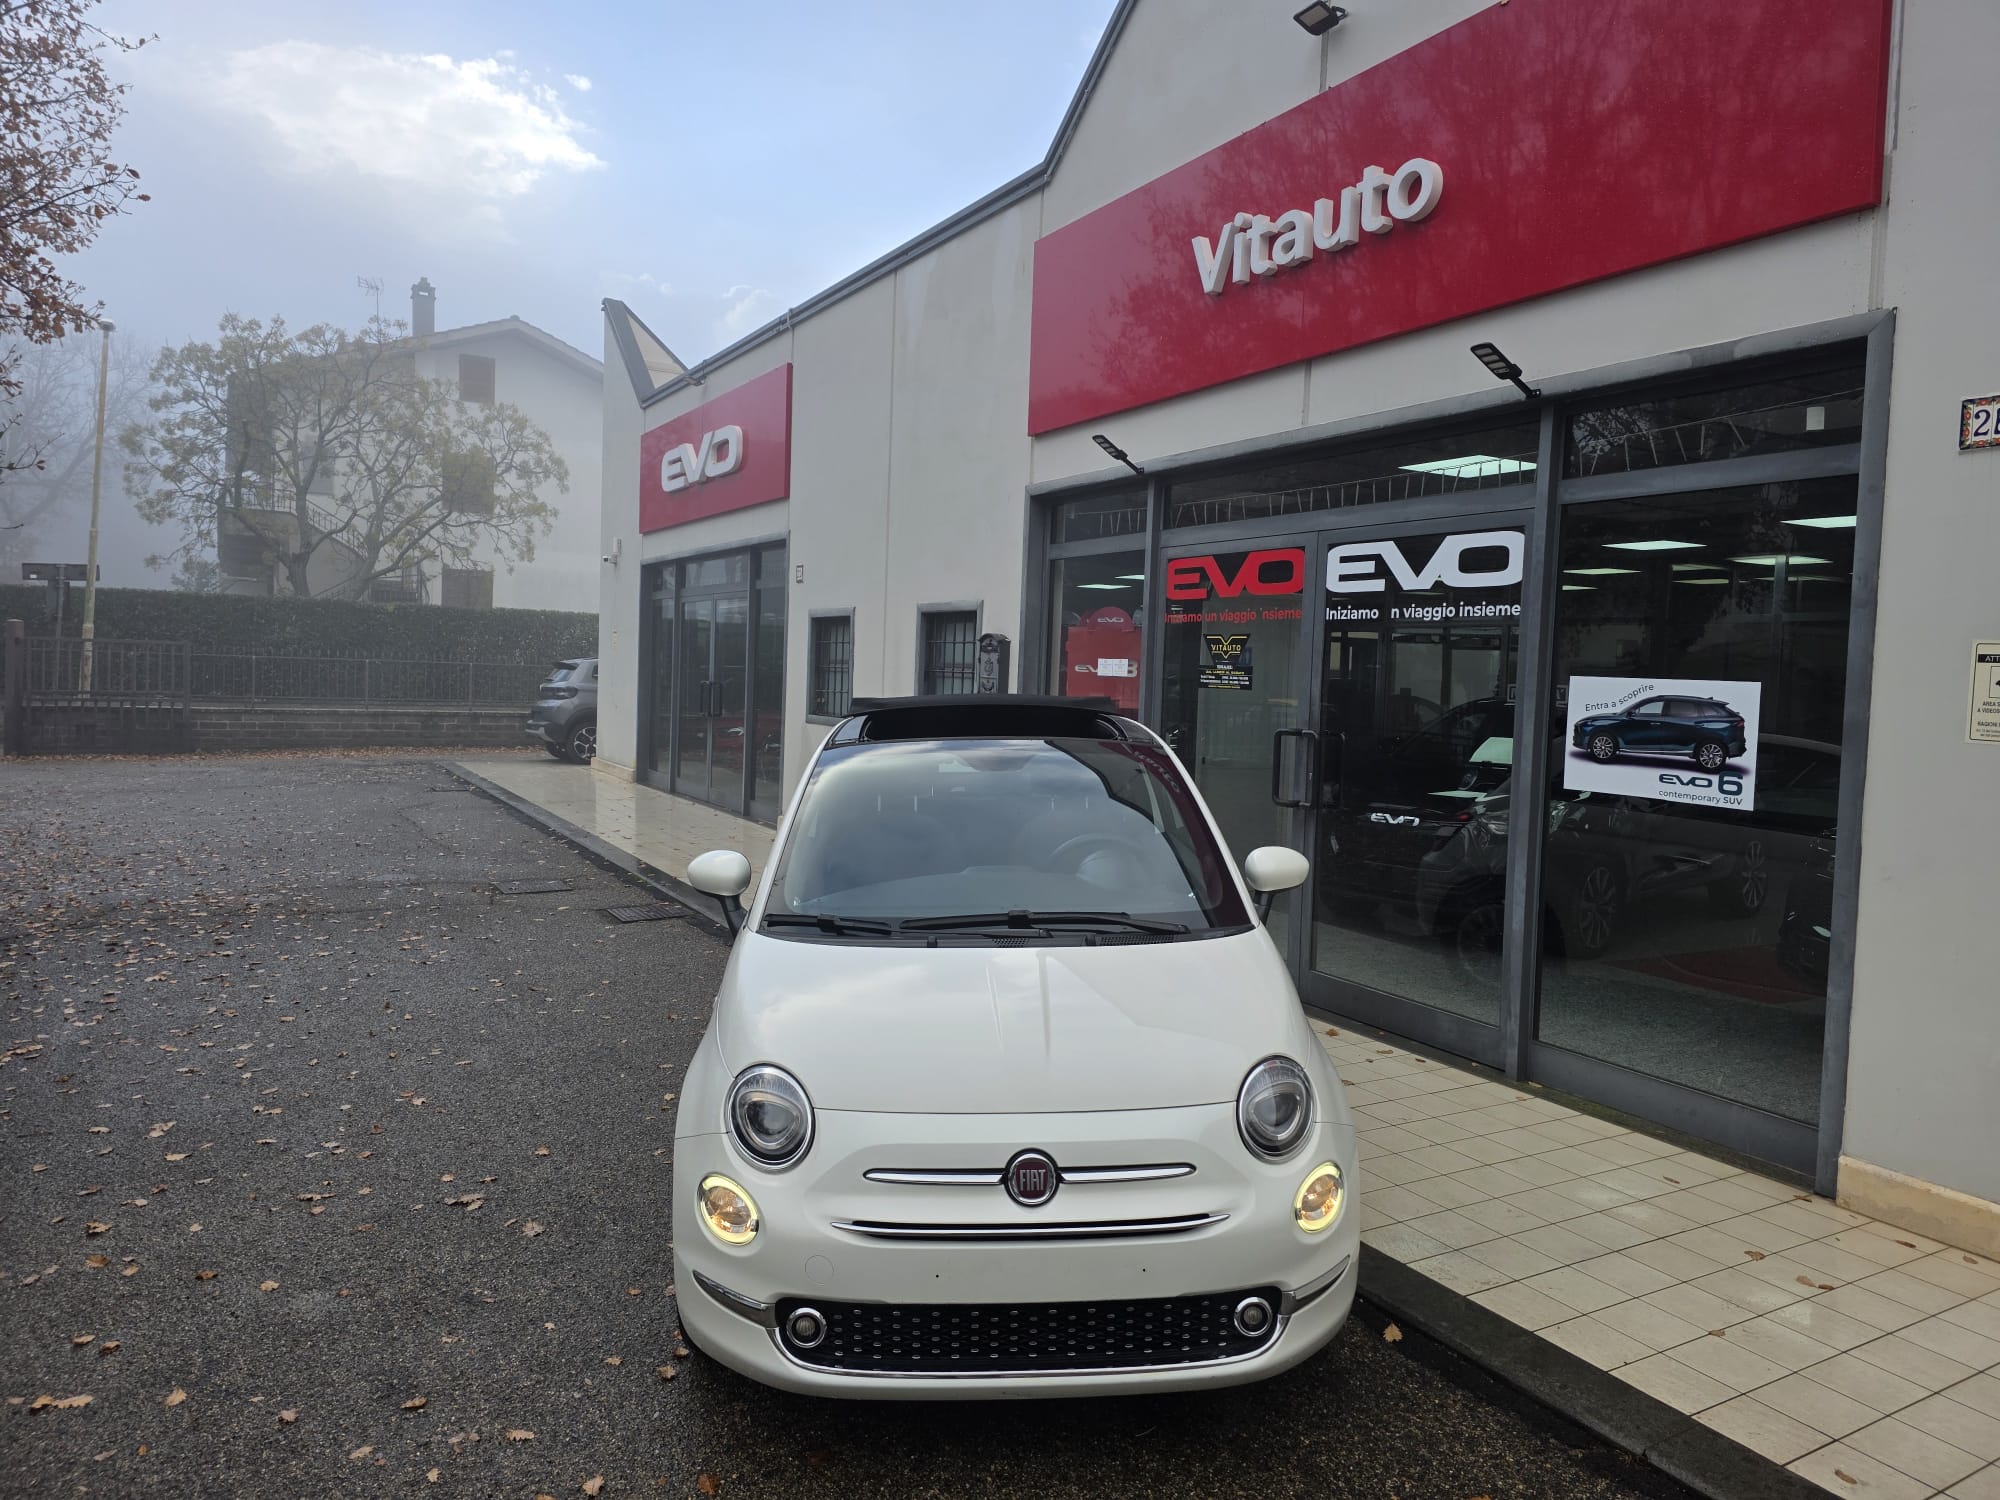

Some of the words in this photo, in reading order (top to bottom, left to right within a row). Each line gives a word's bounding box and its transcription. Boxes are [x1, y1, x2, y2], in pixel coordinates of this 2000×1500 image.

[1192, 157, 1444, 294] Vitauto
[661, 424, 744, 493] EVO
[1166, 548, 1306, 600] EVO
[1326, 530, 1525, 593] EVO
[1220, 608, 1257, 624] viaggio
[1325, 605, 1379, 621] Iniziamo
[1403, 602, 1456, 621] viaggio
[1459, 601, 1521, 618] insieme
[1585, 702, 1609, 712] Entra
[1618, 684, 1654, 705] scoprire
[1659, 773, 1713, 788] EVO
[1718, 770, 1744, 796] 6
[1659, 790, 1720, 804] contemporary
[1723, 796, 1743, 806] SUV
[1020, 1169, 1046, 1191] FIAT
